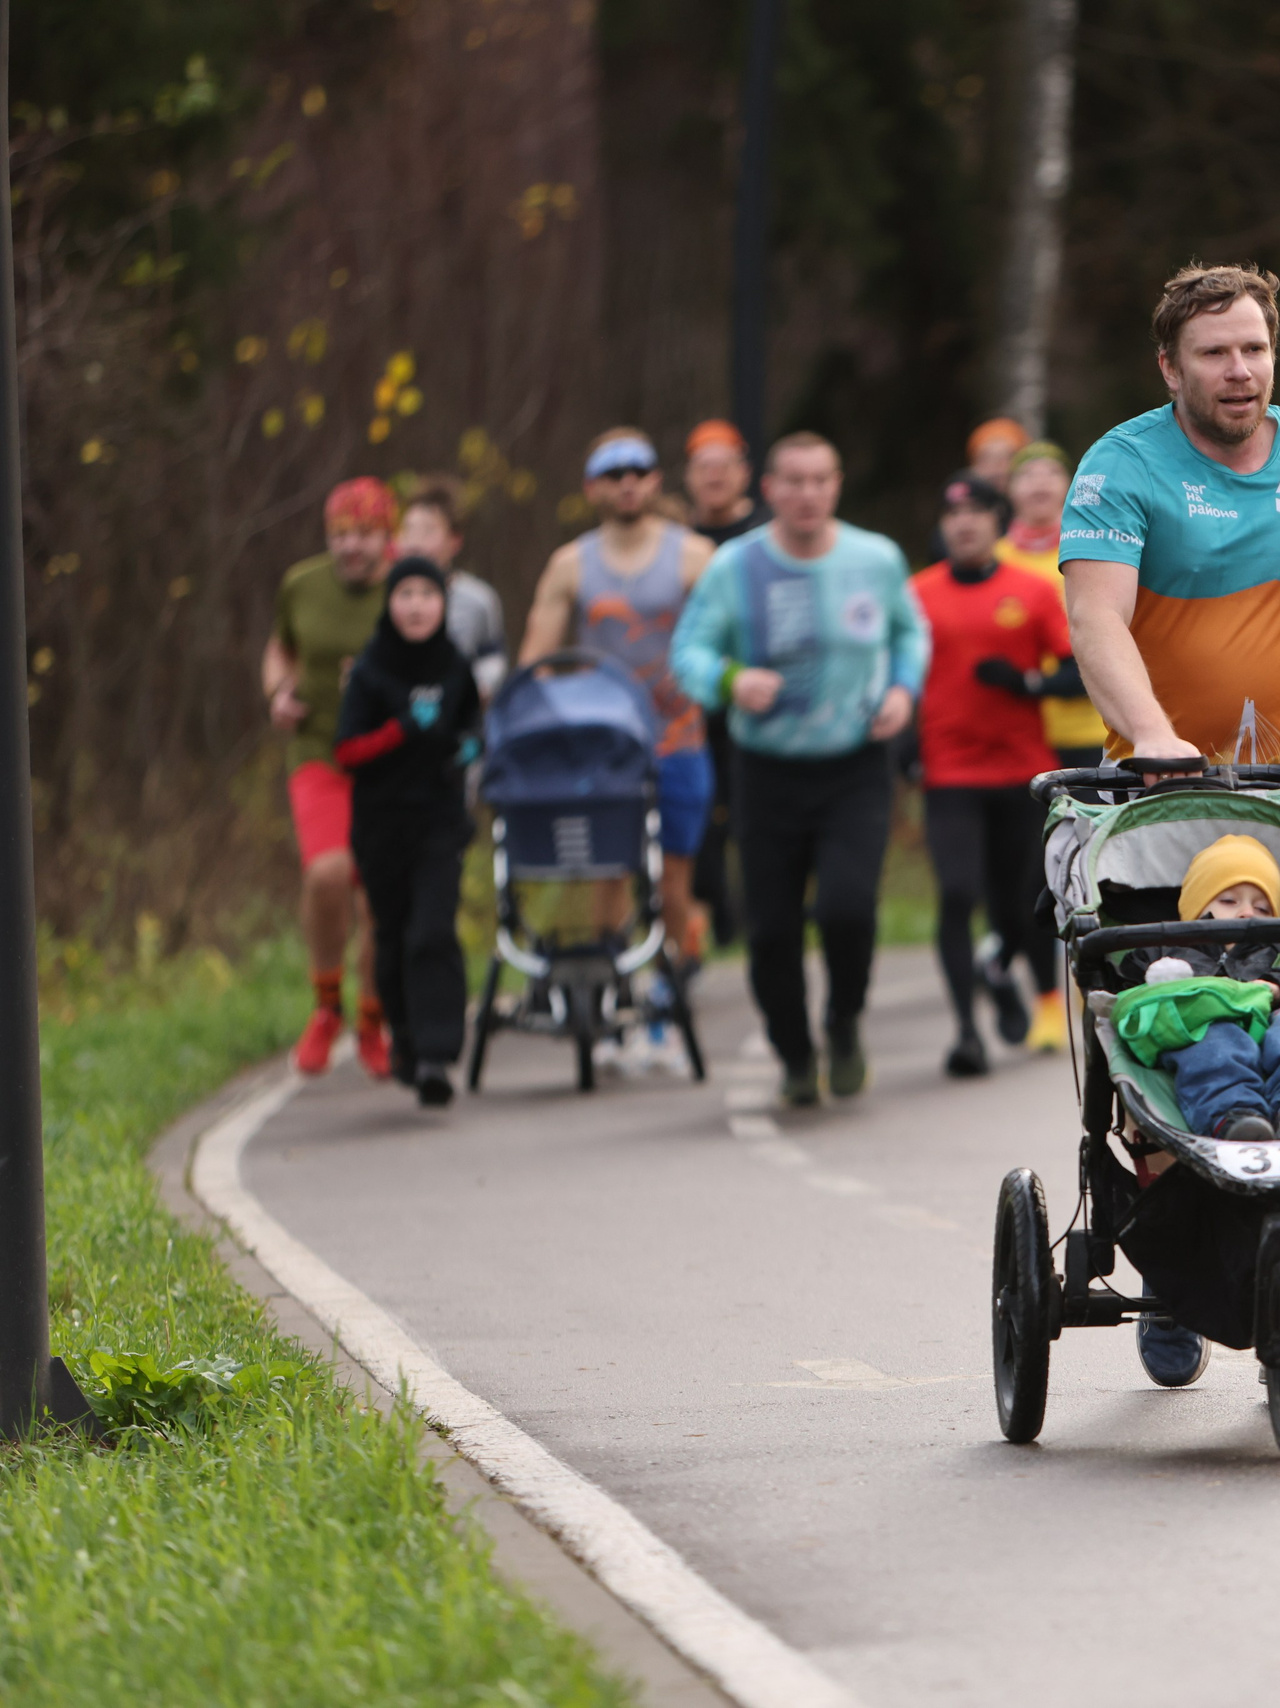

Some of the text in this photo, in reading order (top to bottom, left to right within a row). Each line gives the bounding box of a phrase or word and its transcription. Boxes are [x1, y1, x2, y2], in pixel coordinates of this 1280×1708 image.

[1181, 481, 1207, 495] бег
[1186, 492, 1204, 502] на
[1188, 502, 1238, 519] районе
